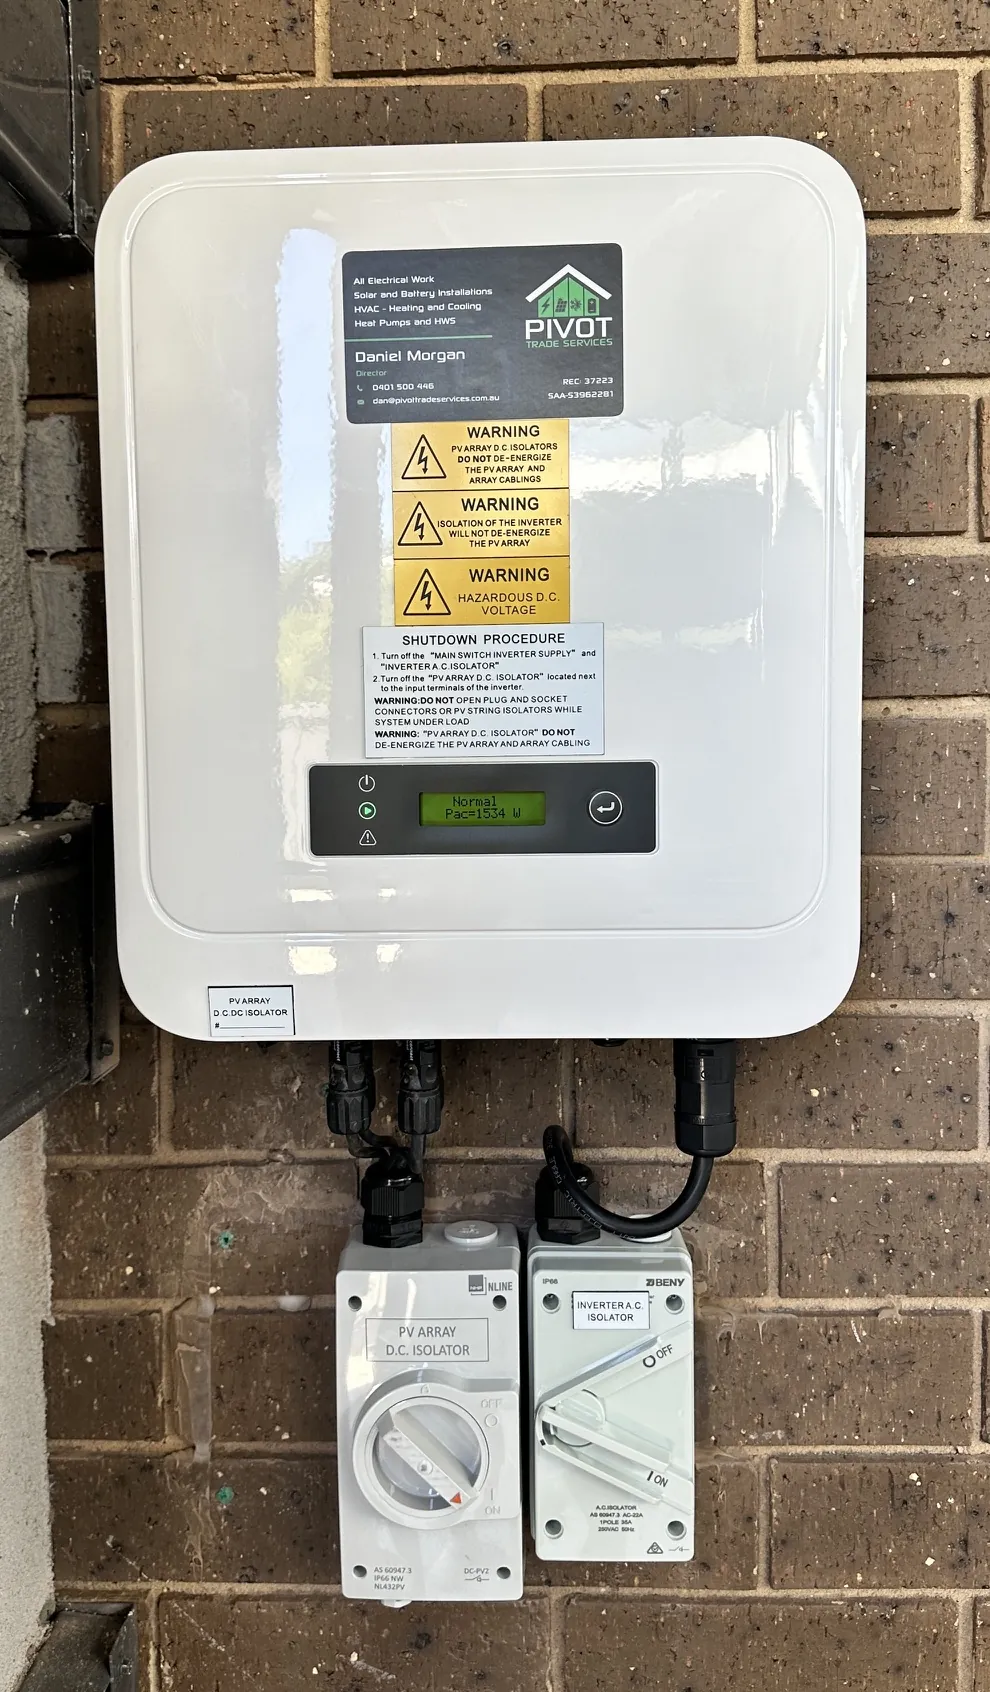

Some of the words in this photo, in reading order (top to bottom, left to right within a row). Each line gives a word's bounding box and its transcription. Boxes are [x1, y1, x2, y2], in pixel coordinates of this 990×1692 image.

[353, 277, 365, 285] All
[368, 276, 408, 285] Electrical
[353, 291, 377, 299] Solar
[400, 290, 435, 299] Battery
[438, 288, 493, 297] Installations
[354, 305, 379, 313] HVAC
[389, 305, 424, 313] Heating
[447, 303, 481, 311] Cooling
[354, 319, 376, 327] Heat
[379, 319, 411, 327] Pumps
[414, 318, 431, 326] and
[434, 317, 456, 325] HWS
[525, 317, 613, 340] PIVOT
[526, 340, 559, 348] TRADE
[563, 338, 613, 347] SERVICES
[355, 351, 401, 363] Daniel
[407, 350, 465, 363] Morgan
[584, 377, 613, 385] 37223
[372, 395, 500, 405] dan@pivottradeservices.com.au
[467, 425, 540, 438] WARNING
[464, 444, 492, 452] ARRAY
[493, 453, 552, 462] DE-ENERGIZE
[465, 466, 481, 474] THE
[495, 465, 524, 473] ARRAY
[499, 475, 541, 483] CABLINGS
[461, 497, 539, 511] WARNING
[437, 519, 483, 527] ISOLATION
[485, 519, 497, 527] OF
[518, 518, 562, 526] INVERTER
[449, 530, 469, 538] WILL
[471, 529, 489, 537] NOT
[491, 528, 550, 537] DE-ENERGIZE
[488, 539, 499, 547] PV
[501, 539, 530, 547] ARRAY
[469, 567, 550, 582] WARNING
[458, 592, 533, 602] HAZARDOUS
[536, 592, 560, 602] D.C.
[481, 605, 536, 615] VOLTAGE
[402, 635, 477, 646] SHUTDOWN
[484, 633, 565, 645] PROCEDURE
[457, 651, 492, 659] SWITCH
[476, 674, 494, 682] D.C.
[405, 684, 425, 692] input
[476, 684, 489, 692] the
[435, 696, 454, 704] NOT
[456, 696, 481, 704] OPEN
[531, 695, 567, 703] SOCKET
[374, 707, 437, 715] CONNECTORS
[439, 707, 452, 715] OR
[468, 706, 501, 715] STRING
[503, 706, 553, 714] ISOLATORS
[554, 705, 582, 713] WHILE
[375, 718, 411, 726] SYSTEM
[413, 718, 444, 726] UNDER
[445, 717, 470, 725] LOAD
[375, 730, 419, 738] WARNING:
[440, 729, 469, 737] ARRAY
[471, 729, 489, 737] D.C.
[375, 741, 435, 749] DE-ENERGIZE
[456, 740, 468, 748] PV
[469, 740, 499, 748] ARRAY
[500, 740, 519, 748] AND
[552, 739, 590, 747] CABLING
[452, 796, 497, 808] Normal
[445, 808, 506, 819] Pac=1534
[513, 808, 521, 819] W
[626, 1301, 644, 1309] A.C.
[399, 1326, 414, 1337] PV
[417, 1326, 457, 1337] ARRAY
[386, 1344, 408, 1356] D.C.
[413, 1344, 470, 1356] ISOLATOR
[656, 1343, 673, 1359] OFF
[654, 1475, 668, 1487] ON
[485, 1506, 501, 1514] ON
